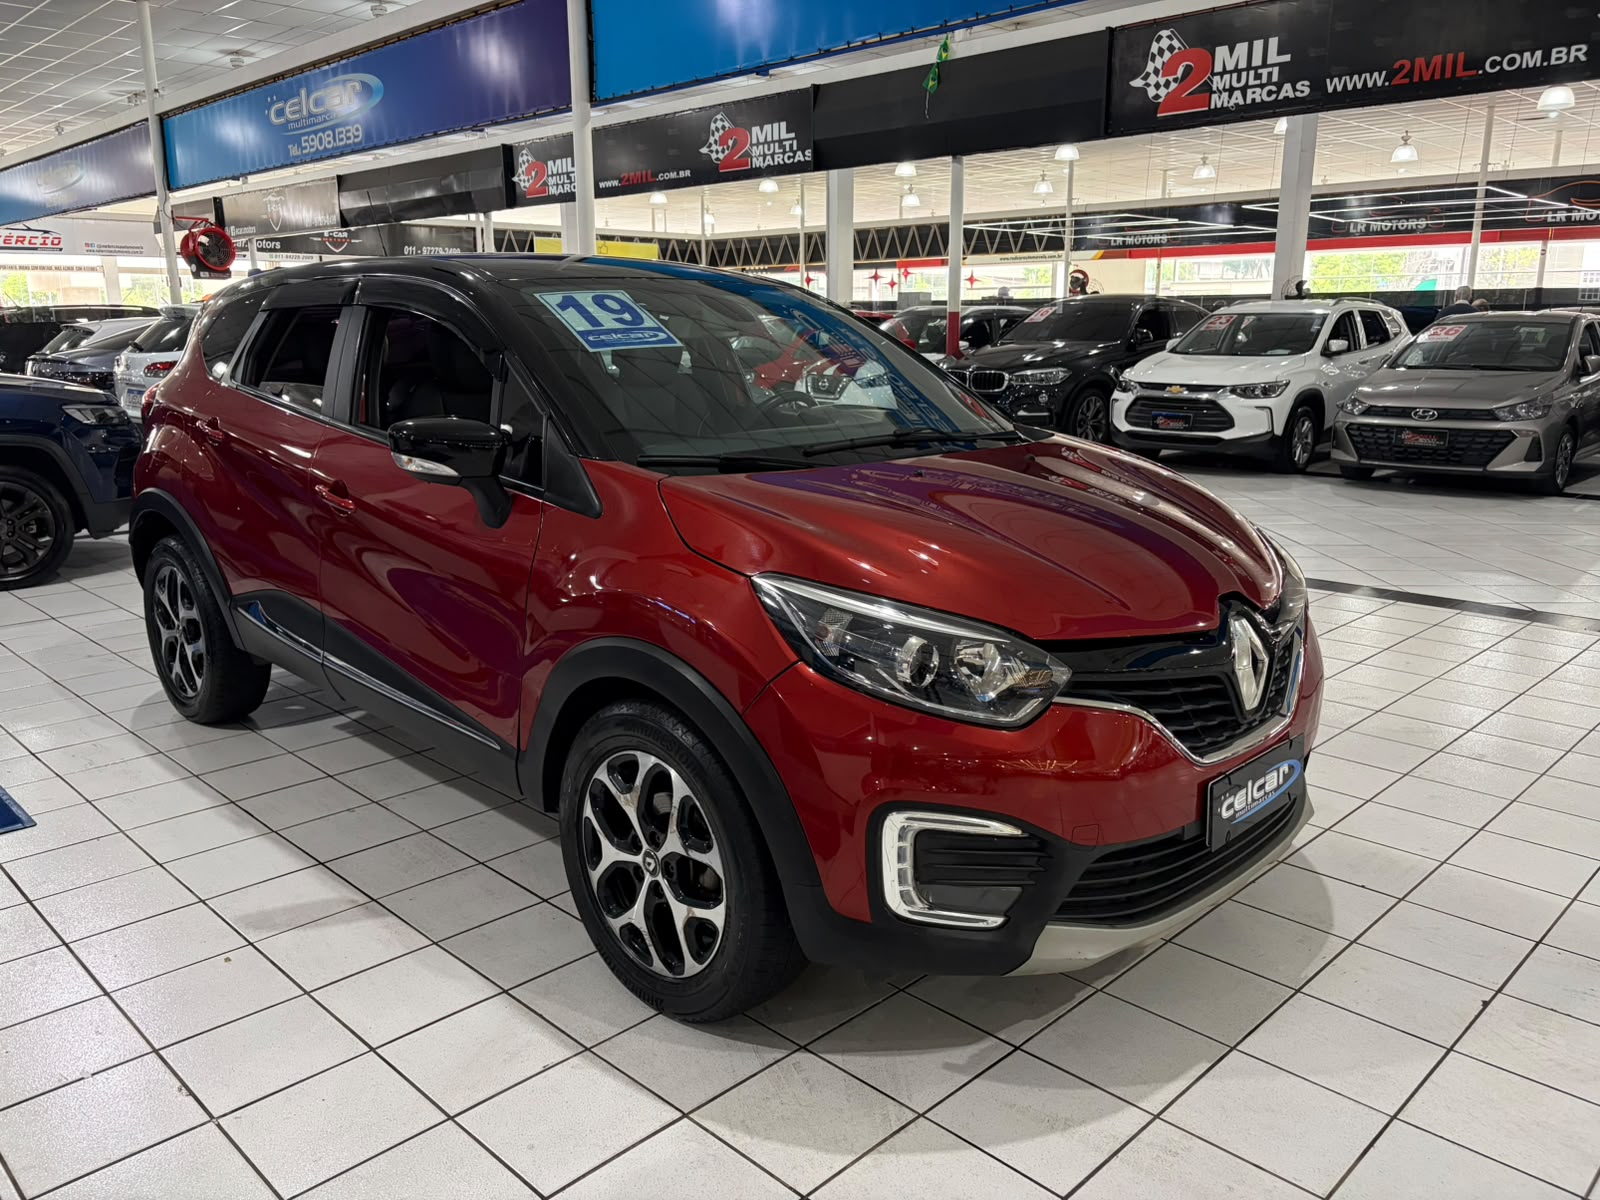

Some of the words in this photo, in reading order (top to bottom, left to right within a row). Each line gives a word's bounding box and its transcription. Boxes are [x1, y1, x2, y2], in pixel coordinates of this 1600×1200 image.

[1157, 48, 1212, 117] 2
[1214, 37, 1291, 73] MIL
[1212, 66, 1280, 91] MULTI
[270, 80, 362, 125] celcar
[1210, 80, 1311, 110] MARCAS
[288, 112, 336, 130] multimarca
[301, 124, 362, 154] 5908.1339
[719, 127, 751, 172] 2
[751, 121, 795, 144] MIL
[752, 139, 797, 156] MULTI
[752, 149, 812, 168] MARCAS
[525, 160, 548, 198] 2
[547, 156, 576, 175] MIL
[548, 173, 576, 185] MULT
[549, 183, 577, 195] MARC
[1571, 209, 1600, 221] MO
[1350, 221, 1367, 233] LR
[1370, 217, 1427, 232] MOTORS
[0, 232, 62, 246] ÉRCIO
[1126, 234, 1168, 245] MOTORS
[404, 245, 416, 255] 011
[555, 294, 645, 328] 19
[1208, 315, 1235, 325] 23
[587, 331, 657, 341] celcar
[1221, 764, 1289, 819] celcar
